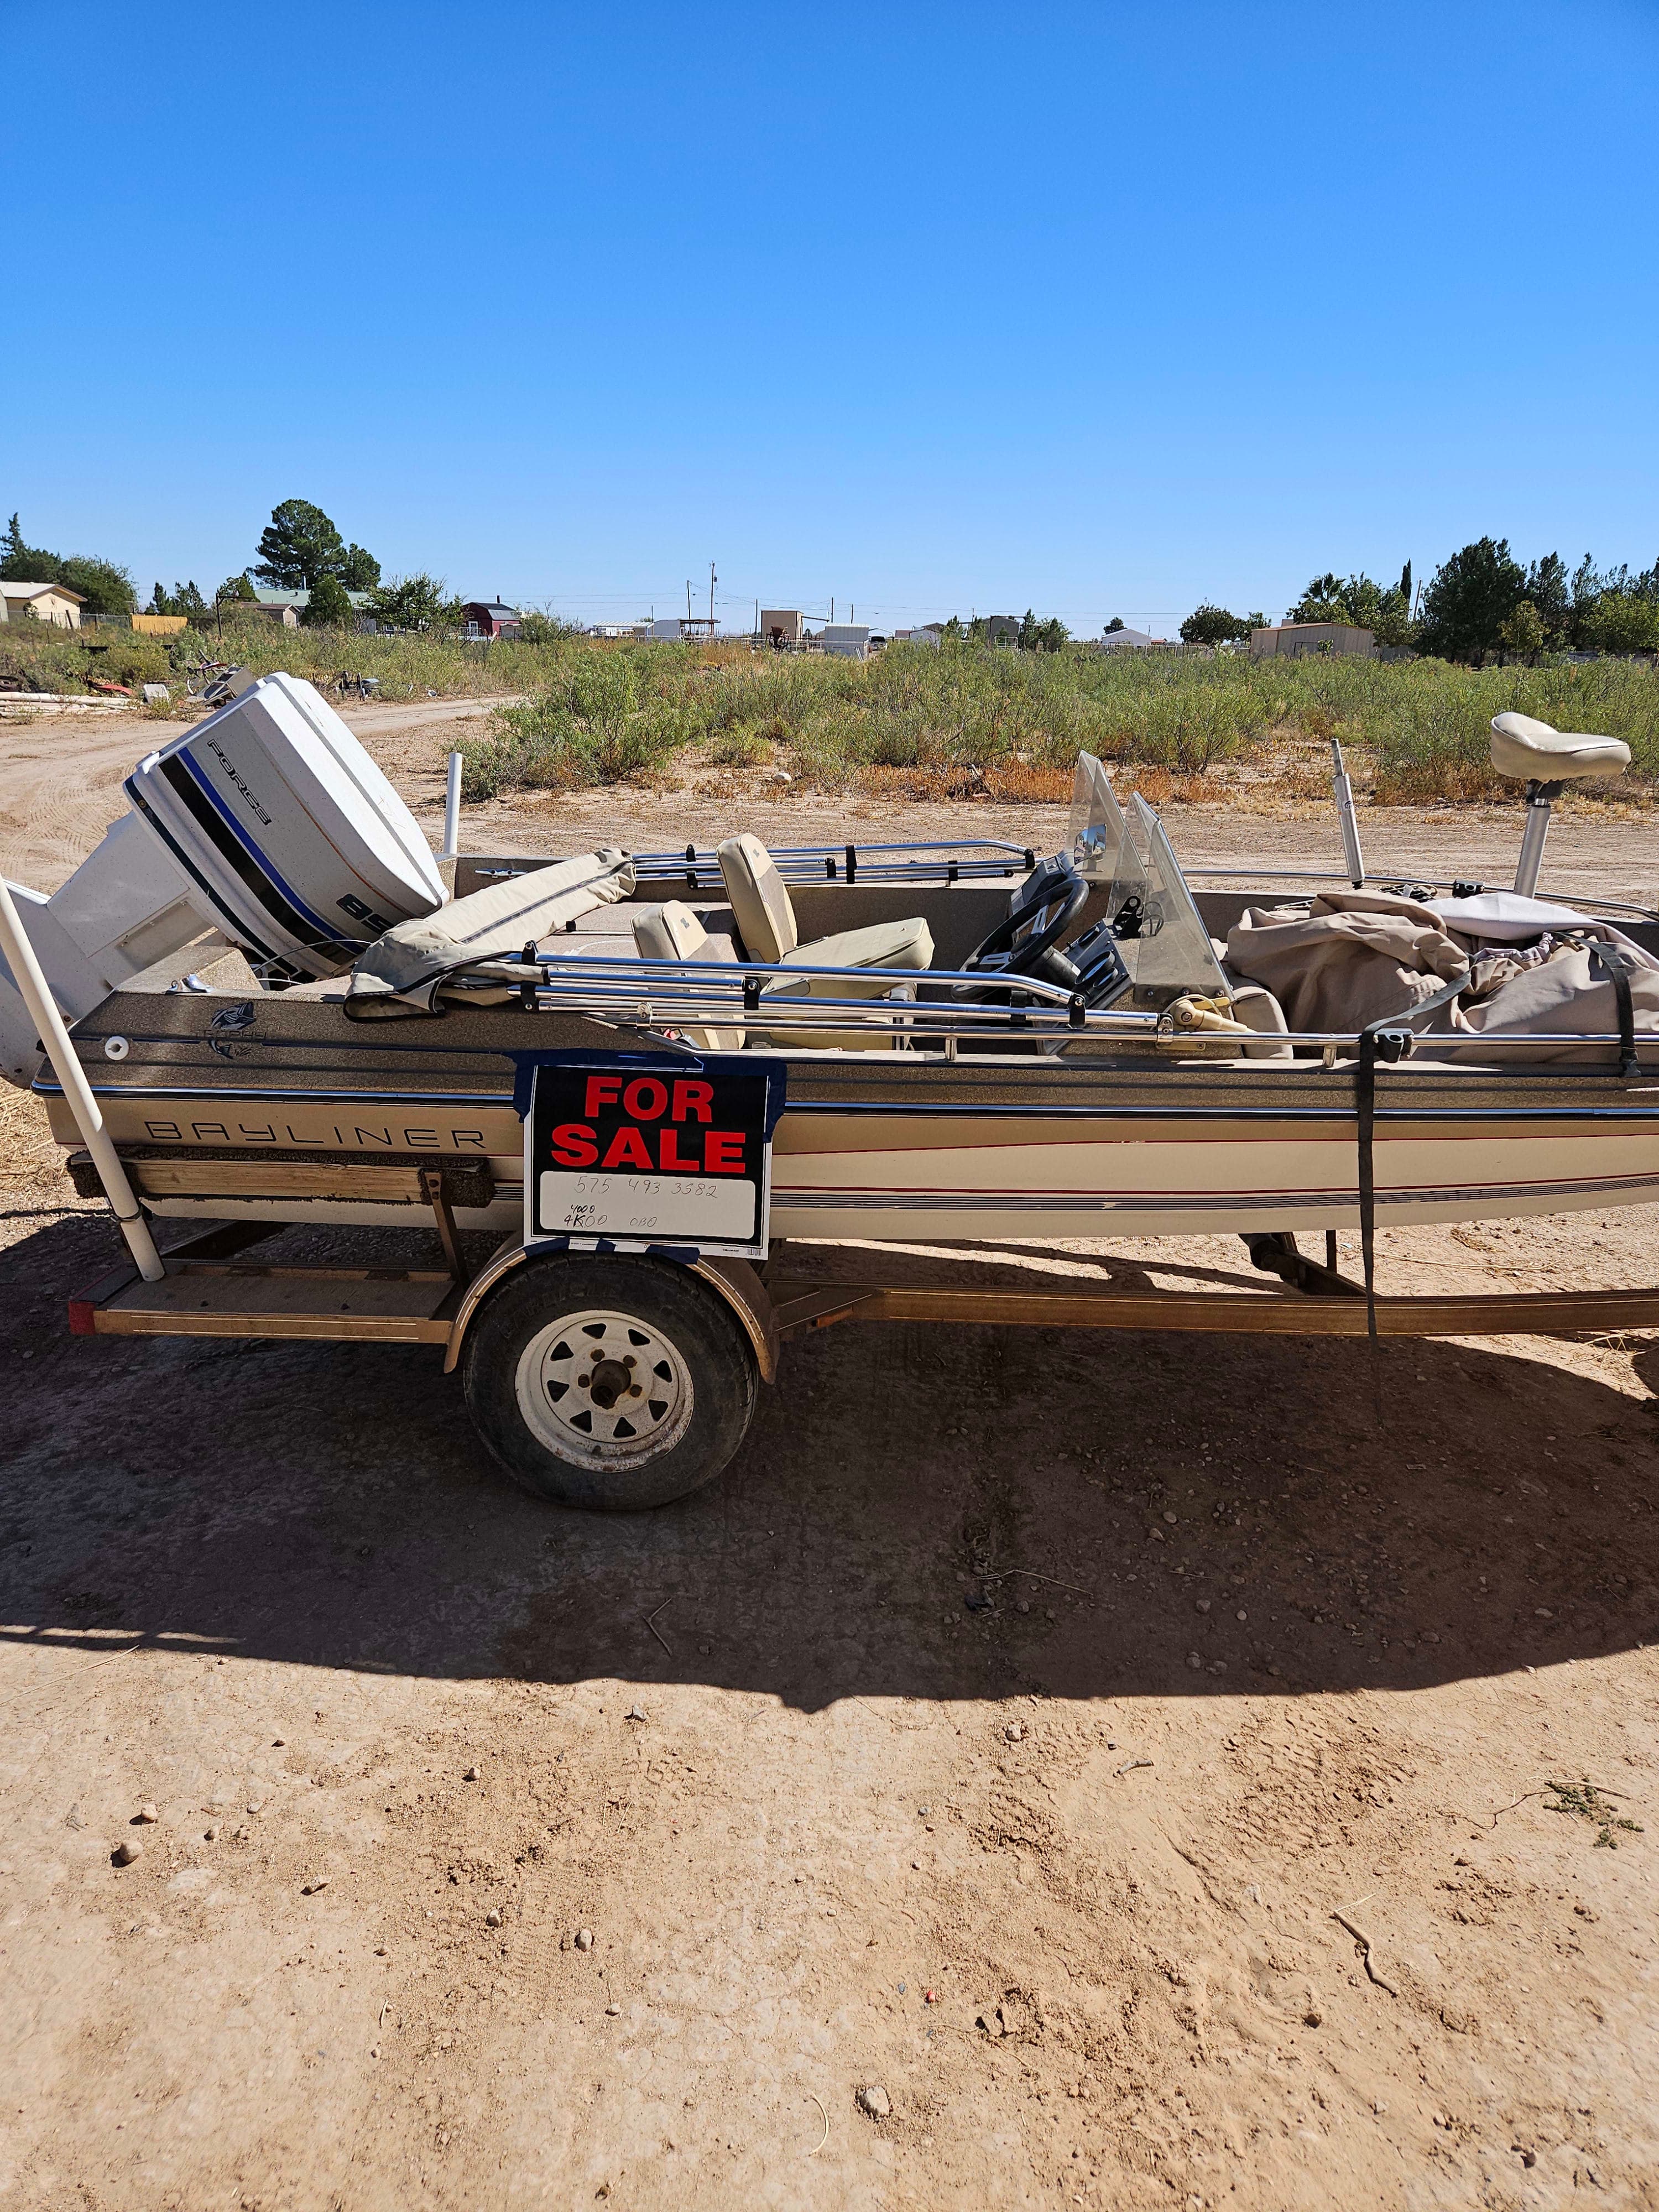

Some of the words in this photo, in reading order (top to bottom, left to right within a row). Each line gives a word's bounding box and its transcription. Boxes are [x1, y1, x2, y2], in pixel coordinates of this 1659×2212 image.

[207, 738, 272, 826] FORCE
[585, 1076, 713, 1122] FOR
[144, 1121, 487, 1149] BAYLINER
[551, 1124, 745, 1173] SALE
[575, 1176, 612, 1193] 575
[628, 1178, 661, 1194] 493
[671, 1182, 718, 1198] 3582
[571, 1204, 596, 1214] 4000
[630, 1217, 658, 1227] OBO
